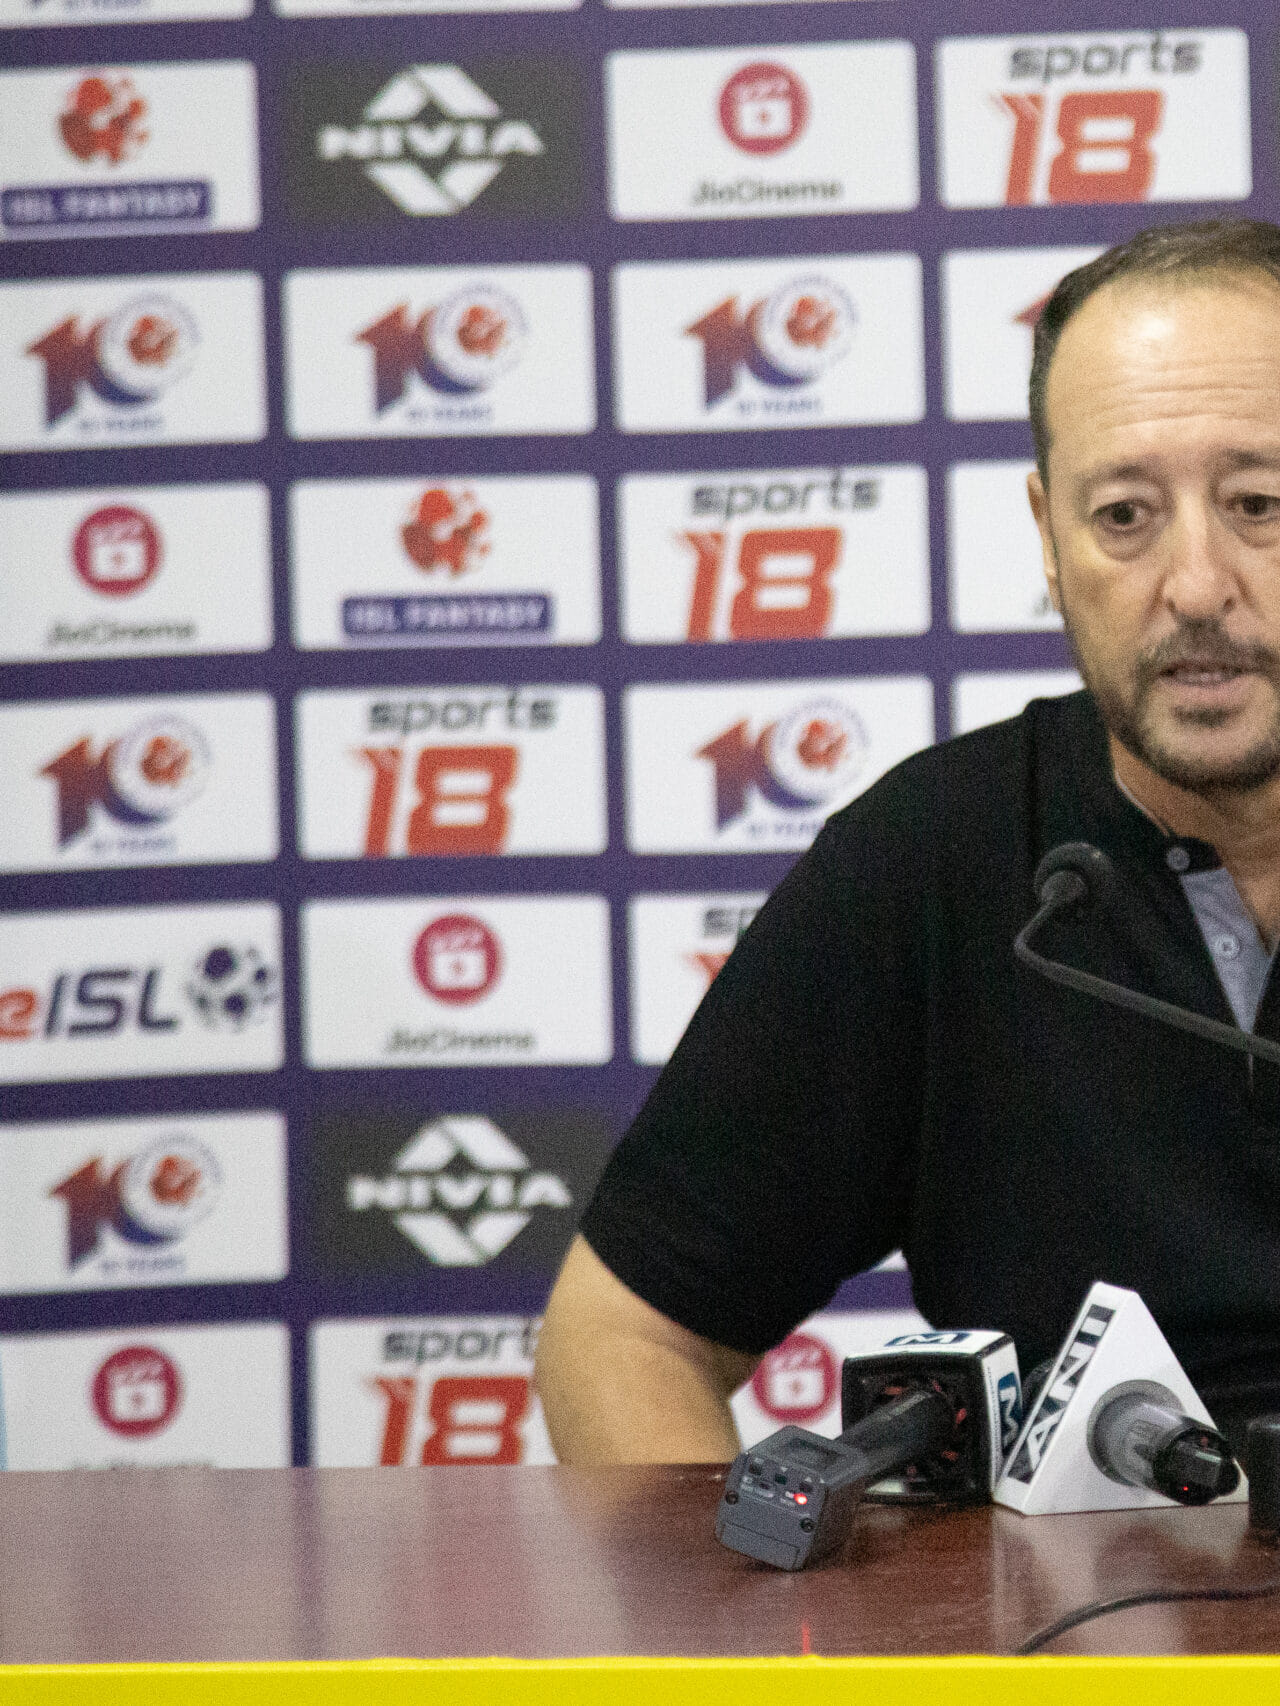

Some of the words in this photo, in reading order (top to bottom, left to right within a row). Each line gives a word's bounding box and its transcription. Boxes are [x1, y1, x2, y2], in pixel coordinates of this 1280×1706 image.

[1009, 32, 1203, 84] sports
[318, 121, 545, 161] NIVIA
[995, 90, 1163, 206] 18
[690, 471, 883, 521] sports
[675, 527, 844, 642] 18
[369, 694, 557, 737] sports
[352, 745, 519, 858] 18
[347, 1174, 574, 1211] NIVIA
[1026, 1316, 1108, 1473] ANI
